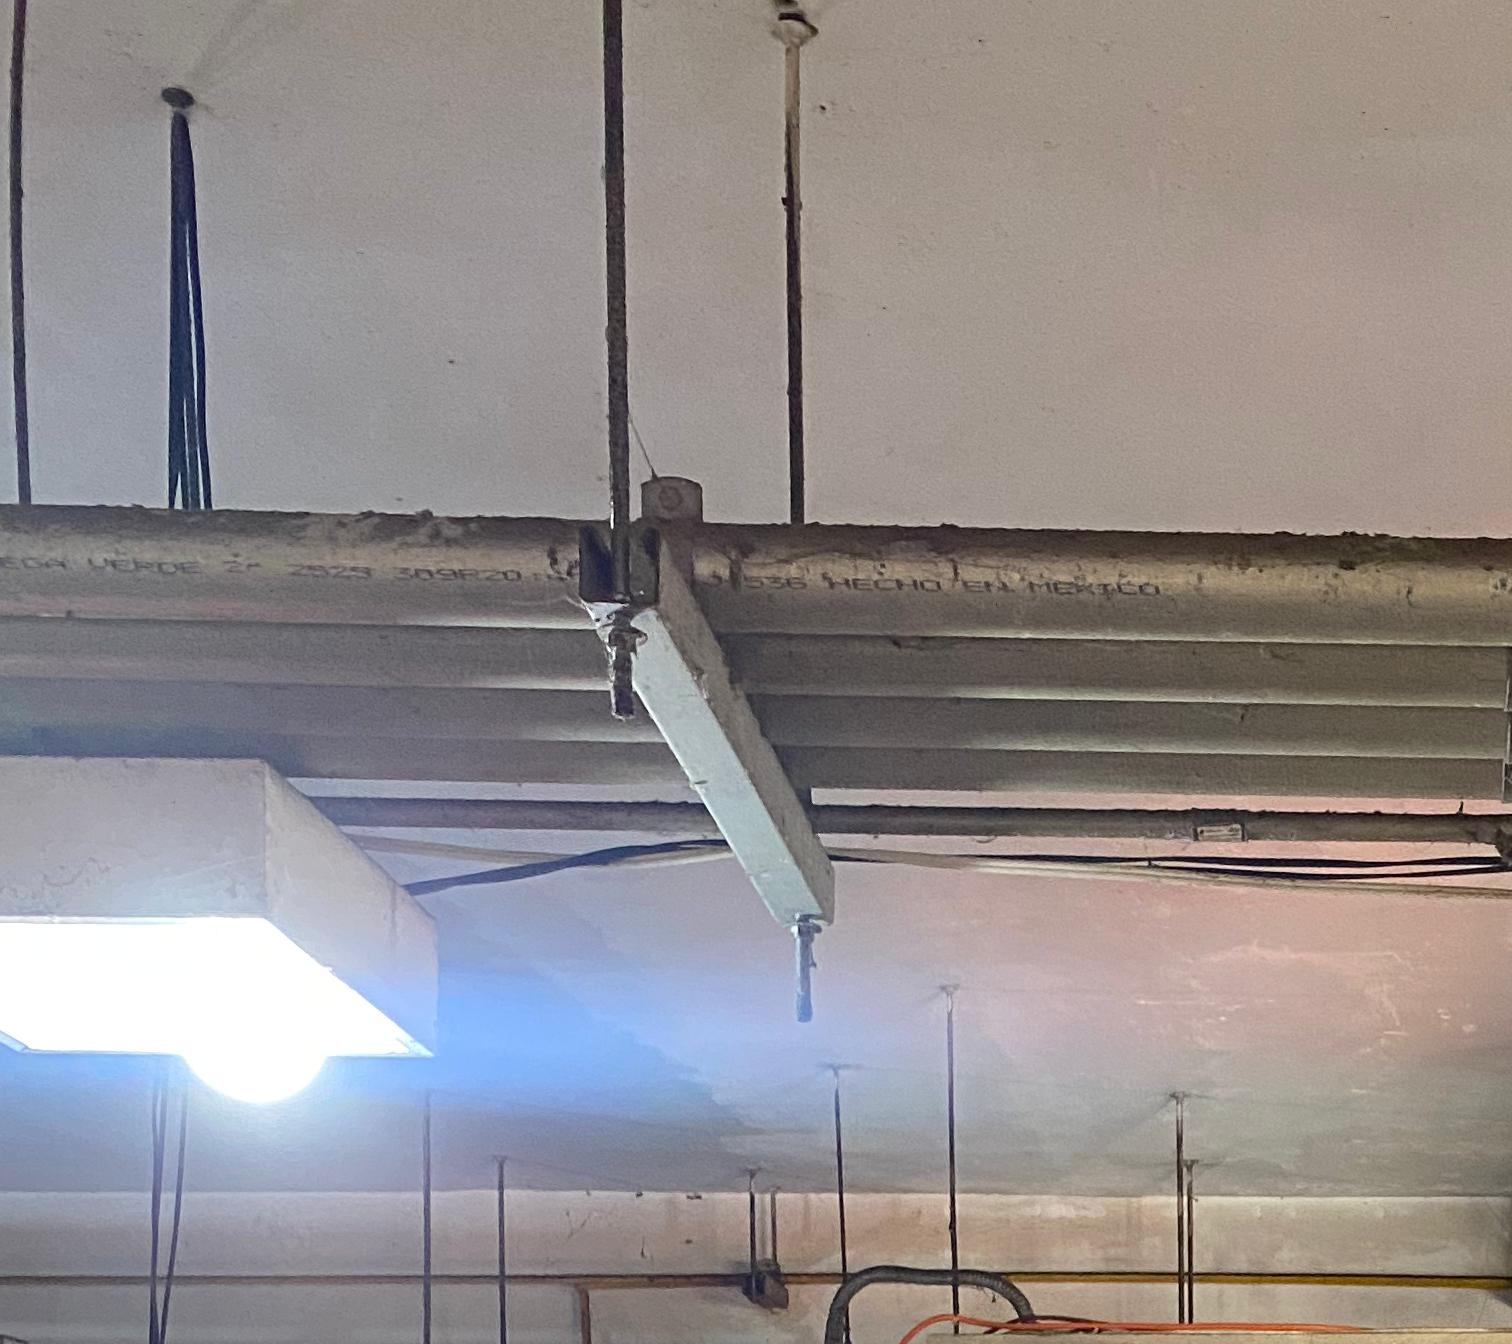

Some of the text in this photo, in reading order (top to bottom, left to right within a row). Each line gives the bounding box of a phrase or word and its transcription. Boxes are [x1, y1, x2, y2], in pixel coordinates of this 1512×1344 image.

[826, 575, 943, 593] HECHO
[963, 578, 1014, 594] EN
[1029, 580, 1161, 597] MEXICO
